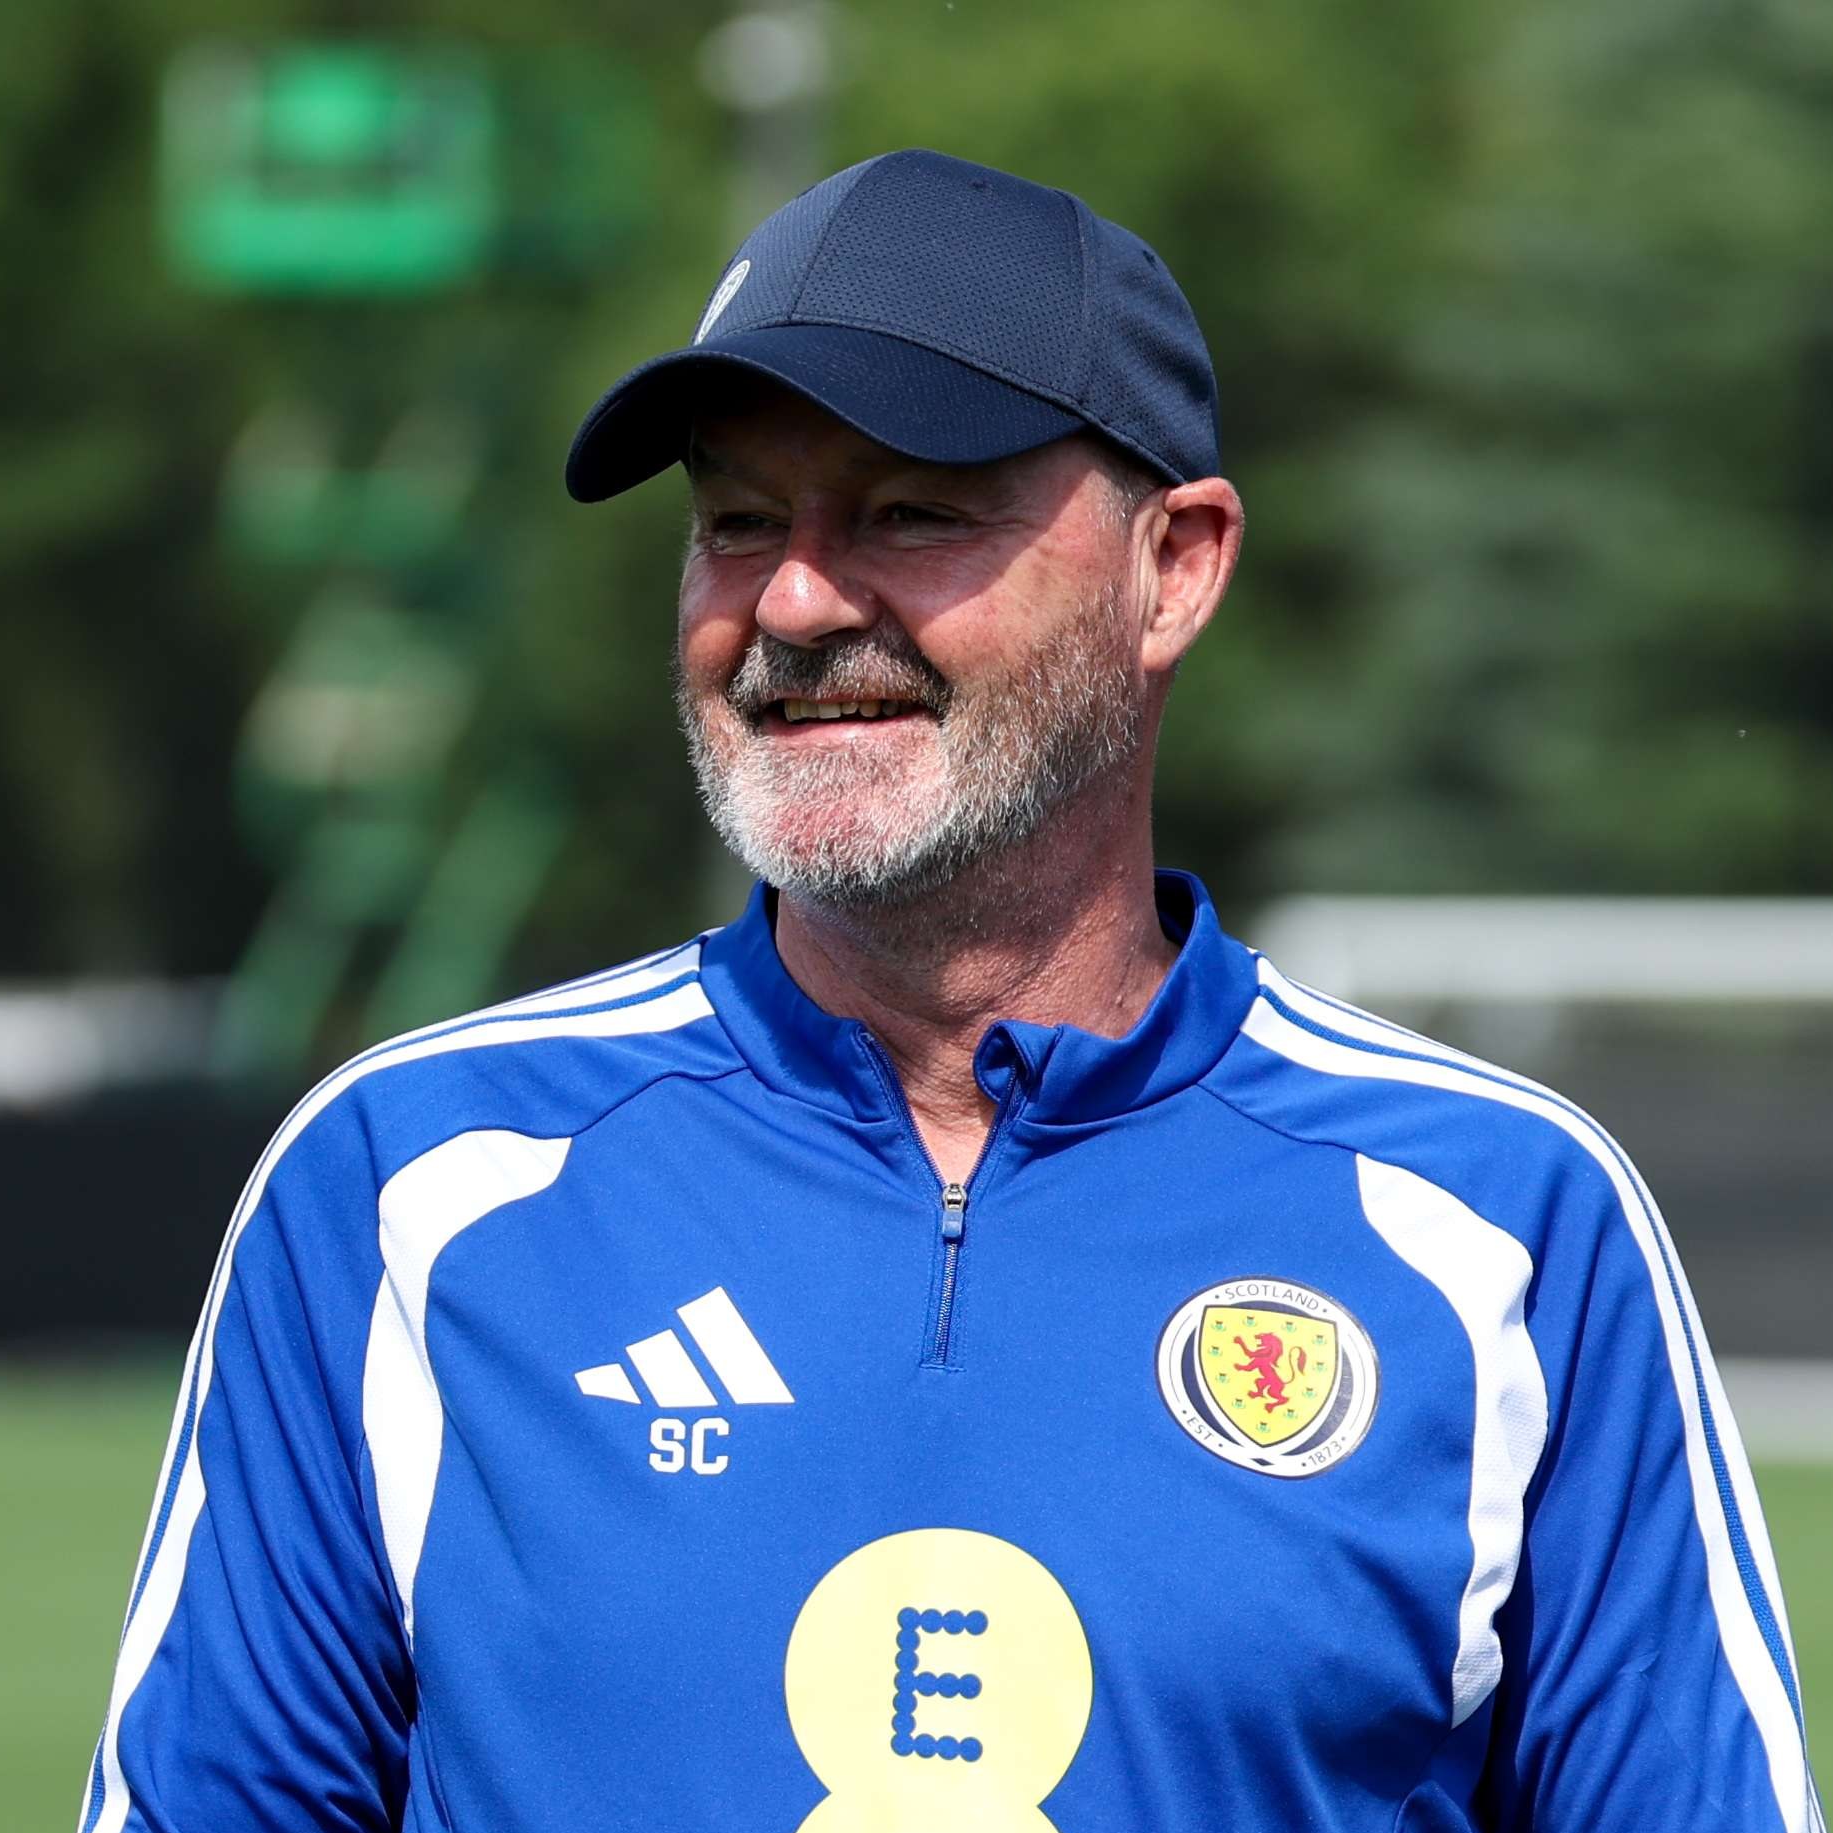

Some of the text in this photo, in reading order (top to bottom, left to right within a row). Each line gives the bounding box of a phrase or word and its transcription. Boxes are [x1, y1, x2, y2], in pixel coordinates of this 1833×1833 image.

[1224, 1283, 1318, 1311] SCOTLAND
[1185, 1415, 1215, 1442] EST
[649, 1417, 730, 1475] SC
[1307, 1440, 1344, 1466] 1873
